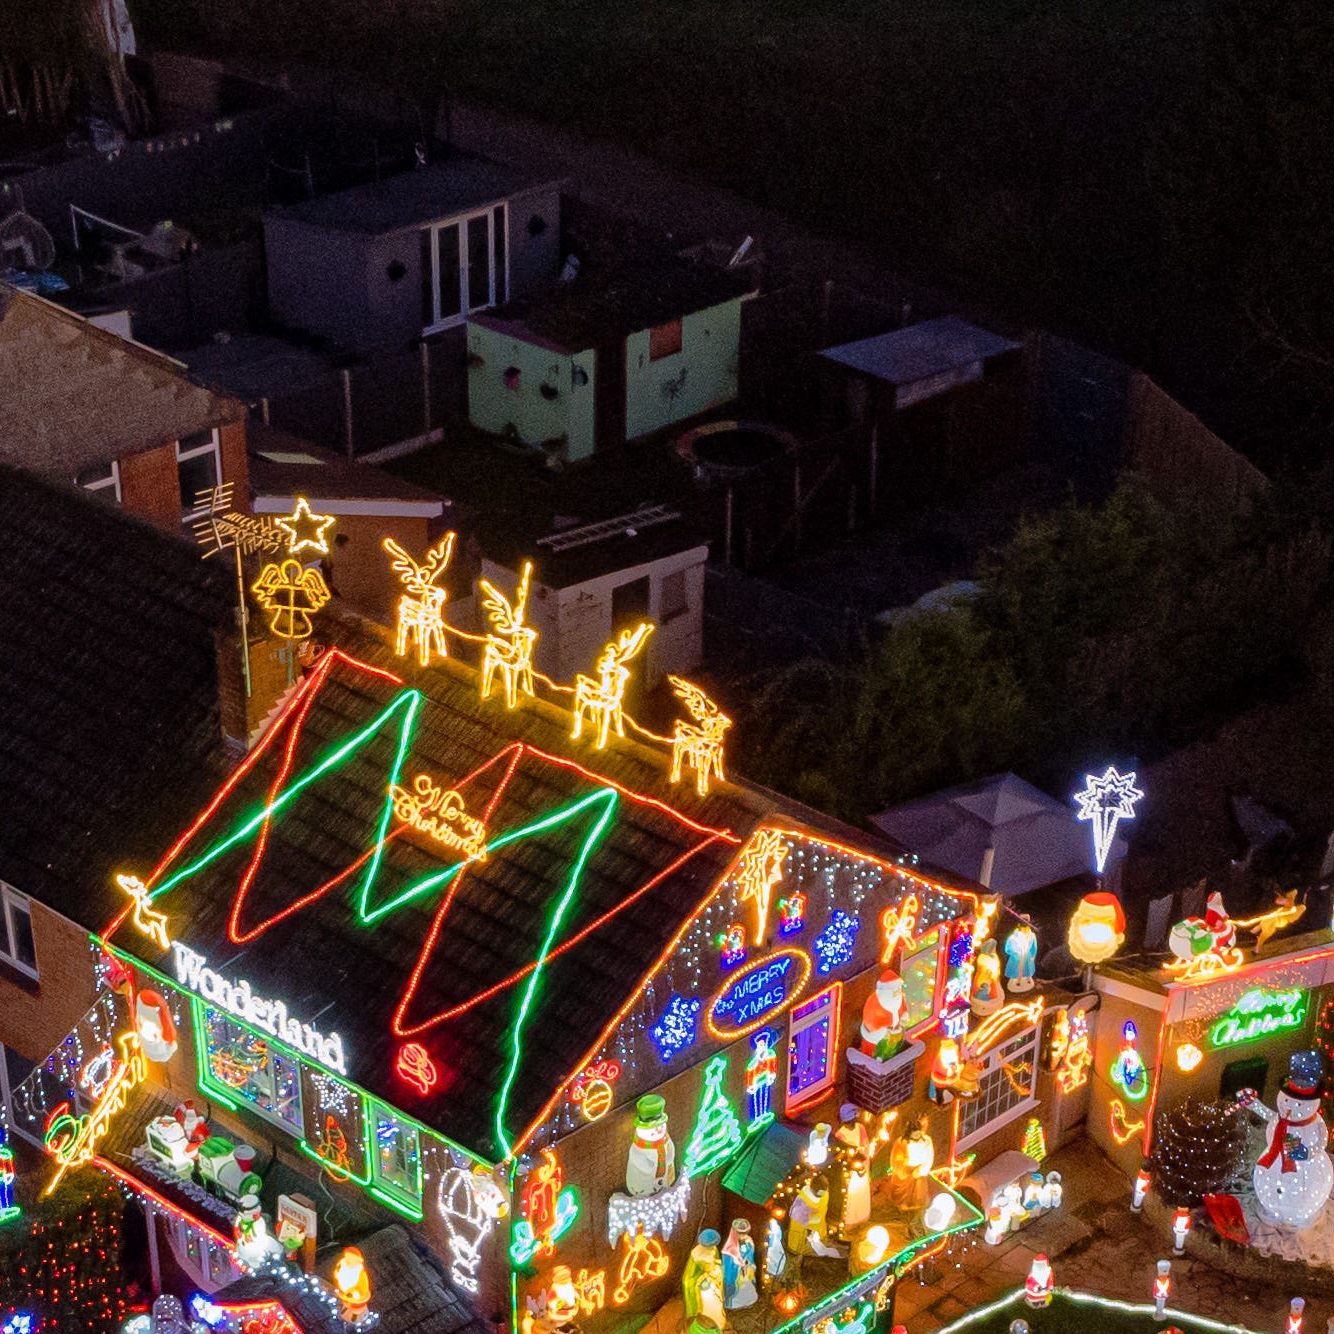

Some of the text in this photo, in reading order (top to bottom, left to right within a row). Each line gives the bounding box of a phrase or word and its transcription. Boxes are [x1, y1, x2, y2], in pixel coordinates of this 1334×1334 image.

[413, 775, 485, 845] Merry
[734, 957, 790, 1000] MERRY
[737, 986, 784, 1024] XMAS
[171, 940, 347, 1075] Wonderland
